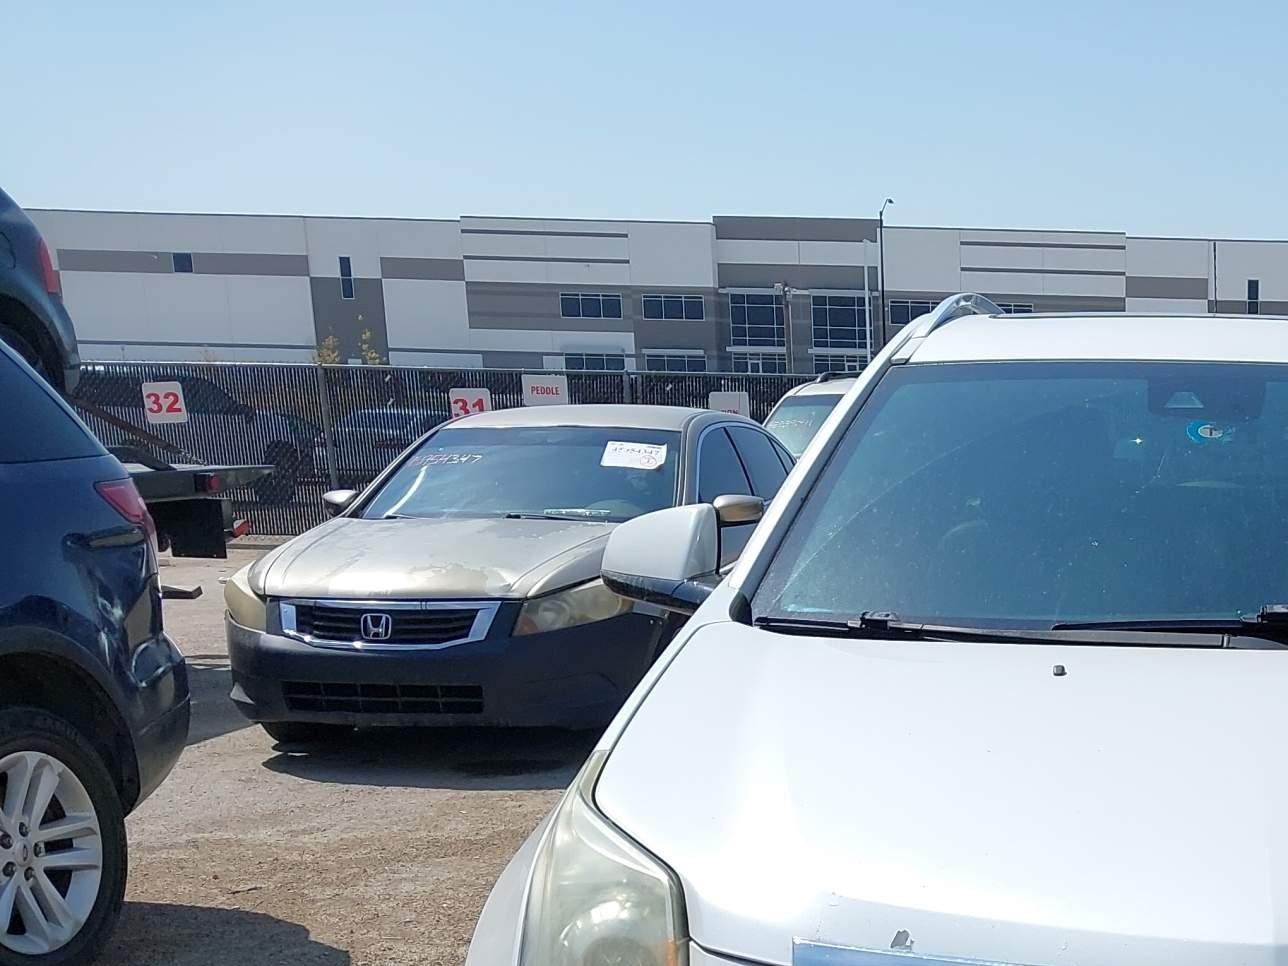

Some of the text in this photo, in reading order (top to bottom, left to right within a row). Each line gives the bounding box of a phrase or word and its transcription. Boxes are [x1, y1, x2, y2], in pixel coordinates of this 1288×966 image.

[530, 385, 561, 396] PEDDLE
[145, 391, 182, 413] 32
[453, 398, 485, 417] 31
